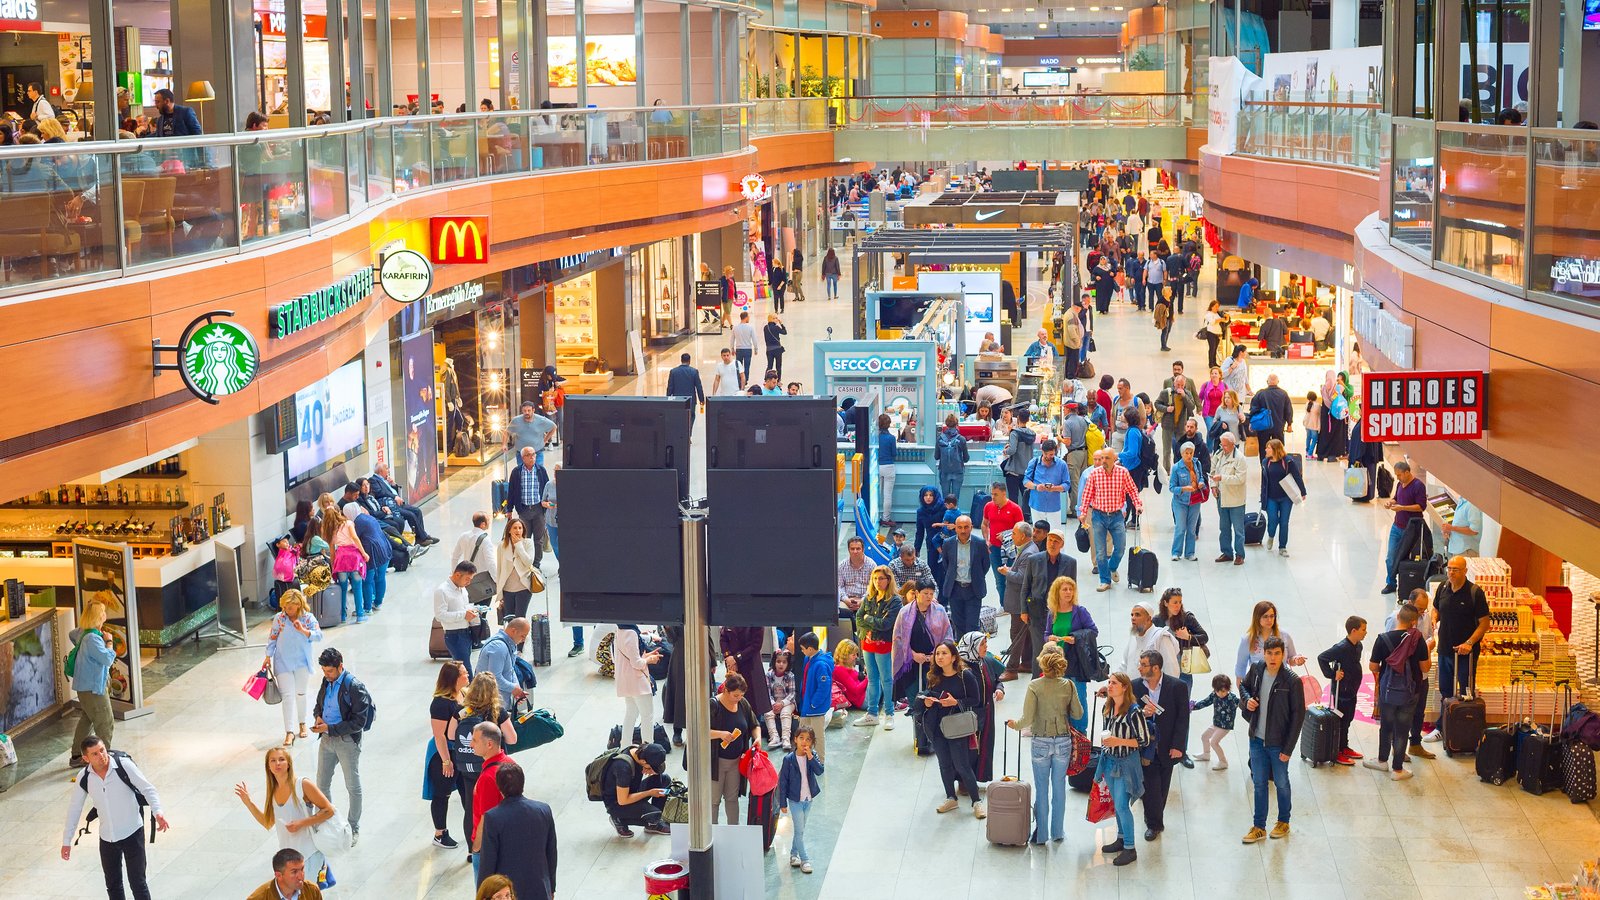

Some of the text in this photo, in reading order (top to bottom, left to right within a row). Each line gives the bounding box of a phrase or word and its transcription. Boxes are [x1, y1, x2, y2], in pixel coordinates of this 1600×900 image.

[277, 284, 347, 340] STARBUCKS
[882, 360, 919, 370] CAFE
[1370, 379, 1476, 406] HEROES
[1368, 411, 1478, 437] SPORTS BAR
